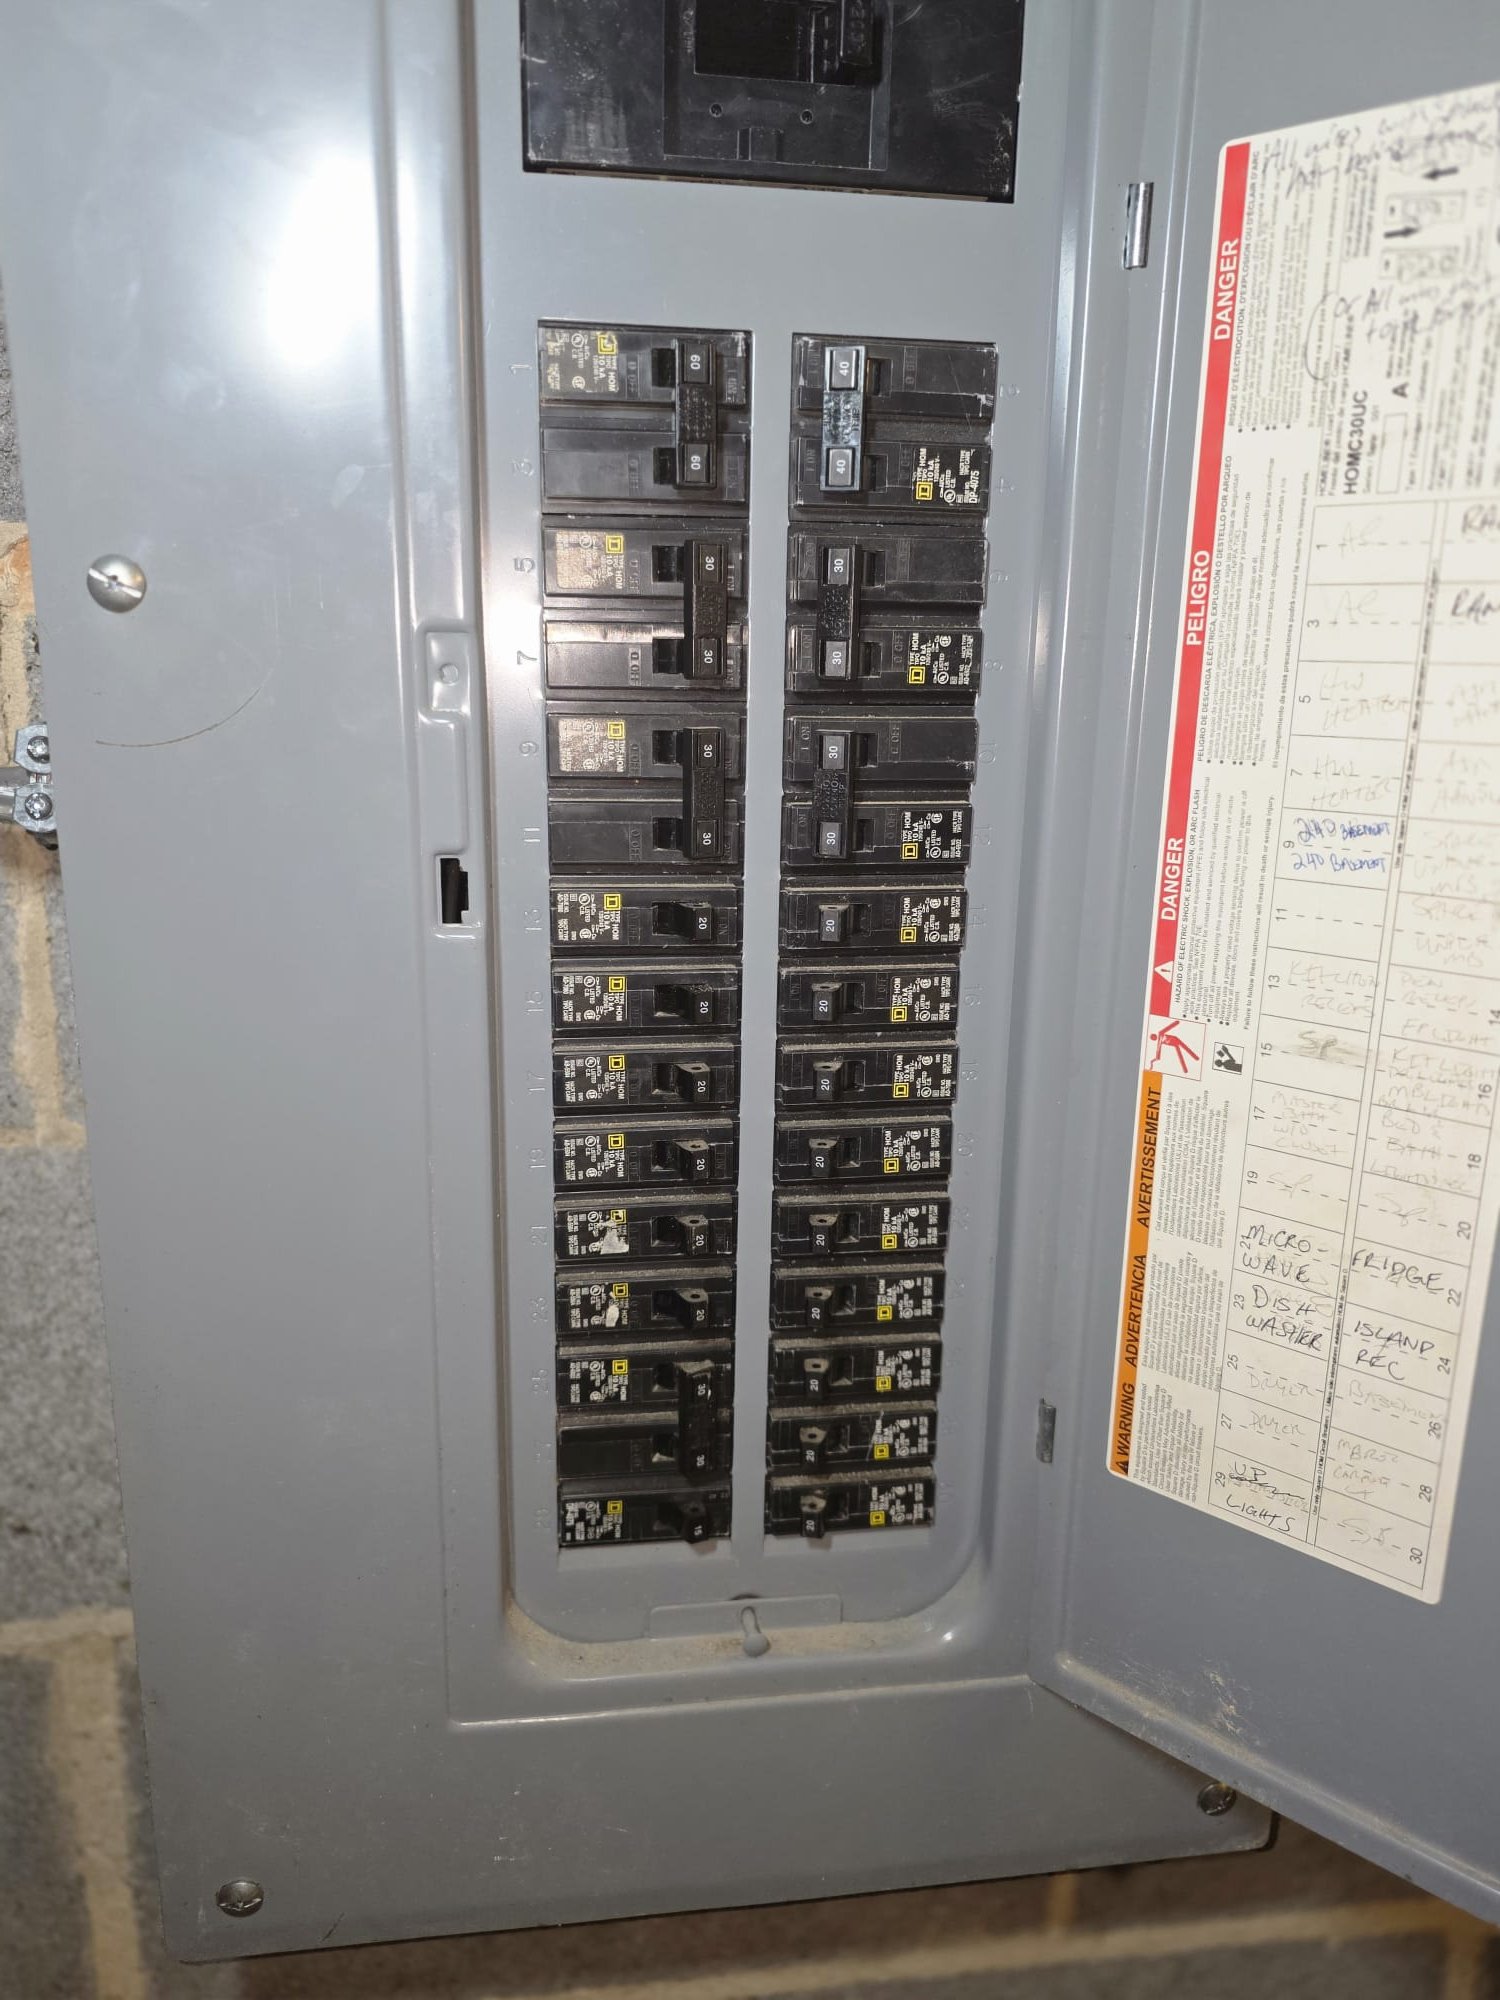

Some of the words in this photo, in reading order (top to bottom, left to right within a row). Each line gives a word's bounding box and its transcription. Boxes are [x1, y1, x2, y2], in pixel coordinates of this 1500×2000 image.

[1214, 239, 1239, 341] DANGER
[691, 355, 700, 369] 60
[840, 361, 849, 376] 40
[1392, 382, 1408, 398] A
[1345, 390, 1368, 494] HOMC30UC
[691, 455, 700, 470] 60
[837, 460, 846, 474] 40
[1223, 456, 1232, 492] ARQUEO
[969, 471, 979, 503] DP-4075
[1217, 515, 1227, 558] DESTELLO
[705, 556, 714, 571] 30
[834, 559, 843, 572] 30
[1186, 550, 1210, 646] PELIGRO
[1307, 619, 1319, 628] 3
[704, 650, 713, 663] 30
[832, 652, 841, 664] 30
[1201, 668, 1212, 712] DESCARGA
[1299, 695, 1311, 703] 5
[1200, 715, 1207, 725] DE
[704, 744, 712, 758] 30
[829, 746, 837, 758] 30
[1197, 728, 1206, 761] PELIGRO
[1192, 790, 1200, 814] FLASH
[703, 832, 711, 845] 30
[827, 832, 835, 844] 30
[1189, 835, 1195, 845] OR
[1292, 853, 1324, 870] 240
[1161, 838, 1183, 921] DANGER
[1251, 918, 1260, 956] instructions
[1263, 818, 1271, 843] serious
[1276, 908, 1288, 921] 11
[699, 917, 707, 929] 20
[826, 919, 835, 932] 20
[1179, 924, 1187, 959] ELECTRIC
[1177, 962, 1183, 971] OF
[1175, 974, 1183, 1002] HAZARD
[1268, 975, 1280, 989] 13
[700, 1001, 708, 1013] 20
[819, 1000, 828, 1012] 20
[1261, 1043, 1272, 1057] 15
[698, 1081, 705, 1092] 20
[821, 1079, 829, 1090] 20
[1478, 1084, 1492, 1098] 16
[1254, 1107, 1265, 1120] 17
[696, 1159, 704, 1170] 20
[816, 1156, 824, 1167] 20
[1137, 1087, 1160, 1228] AVERTISSEMENT
[1467, 1153, 1481, 1169] 18
[1247, 1170, 1258, 1185] 19
[1458, 1221, 1471, 1240] 20
[696, 1235, 704, 1246] 20
[817, 1234, 825, 1246] 20
[1240, 1236, 1251, 1249] 21
[1243, 1253, 1310, 1282] WAVE
[1352, 1249, 1444, 1291] FRIDGE
[1233, 1294, 1244, 1309] 23
[1252, 1285, 1315, 1315] DISH
[1447, 1289, 1462, 1307] 22
[696, 1310, 704, 1320] 20
[812, 1308, 820, 1319] 20
[1125, 1255, 1147, 1367] ADVERTENCIA
[1354, 1321, 1434, 1354] ISLAND
[1227, 1354, 1238, 1370] 25
[1357, 1350, 1404, 1380] REC
[1437, 1357, 1451, 1374] 24
[698, 1384, 705, 1395] 30
[811, 1380, 818, 1391] 20
[1117, 1383, 1135, 1456] WARNING
[1221, 1414, 1232, 1429] 27
[1428, 1421, 1441, 1438] 26
[697, 1455, 705, 1466] 30
[807, 1450, 814, 1462] 20
[1215, 1472, 1226, 1487] 29
[1419, 1485, 1431, 1502] 28
[1226, 1494, 1295, 1532] LIGHTS
[694, 1525, 702, 1535] 15
[807, 1520, 814, 1531] 20
[1410, 1548, 1423, 1564] 30
